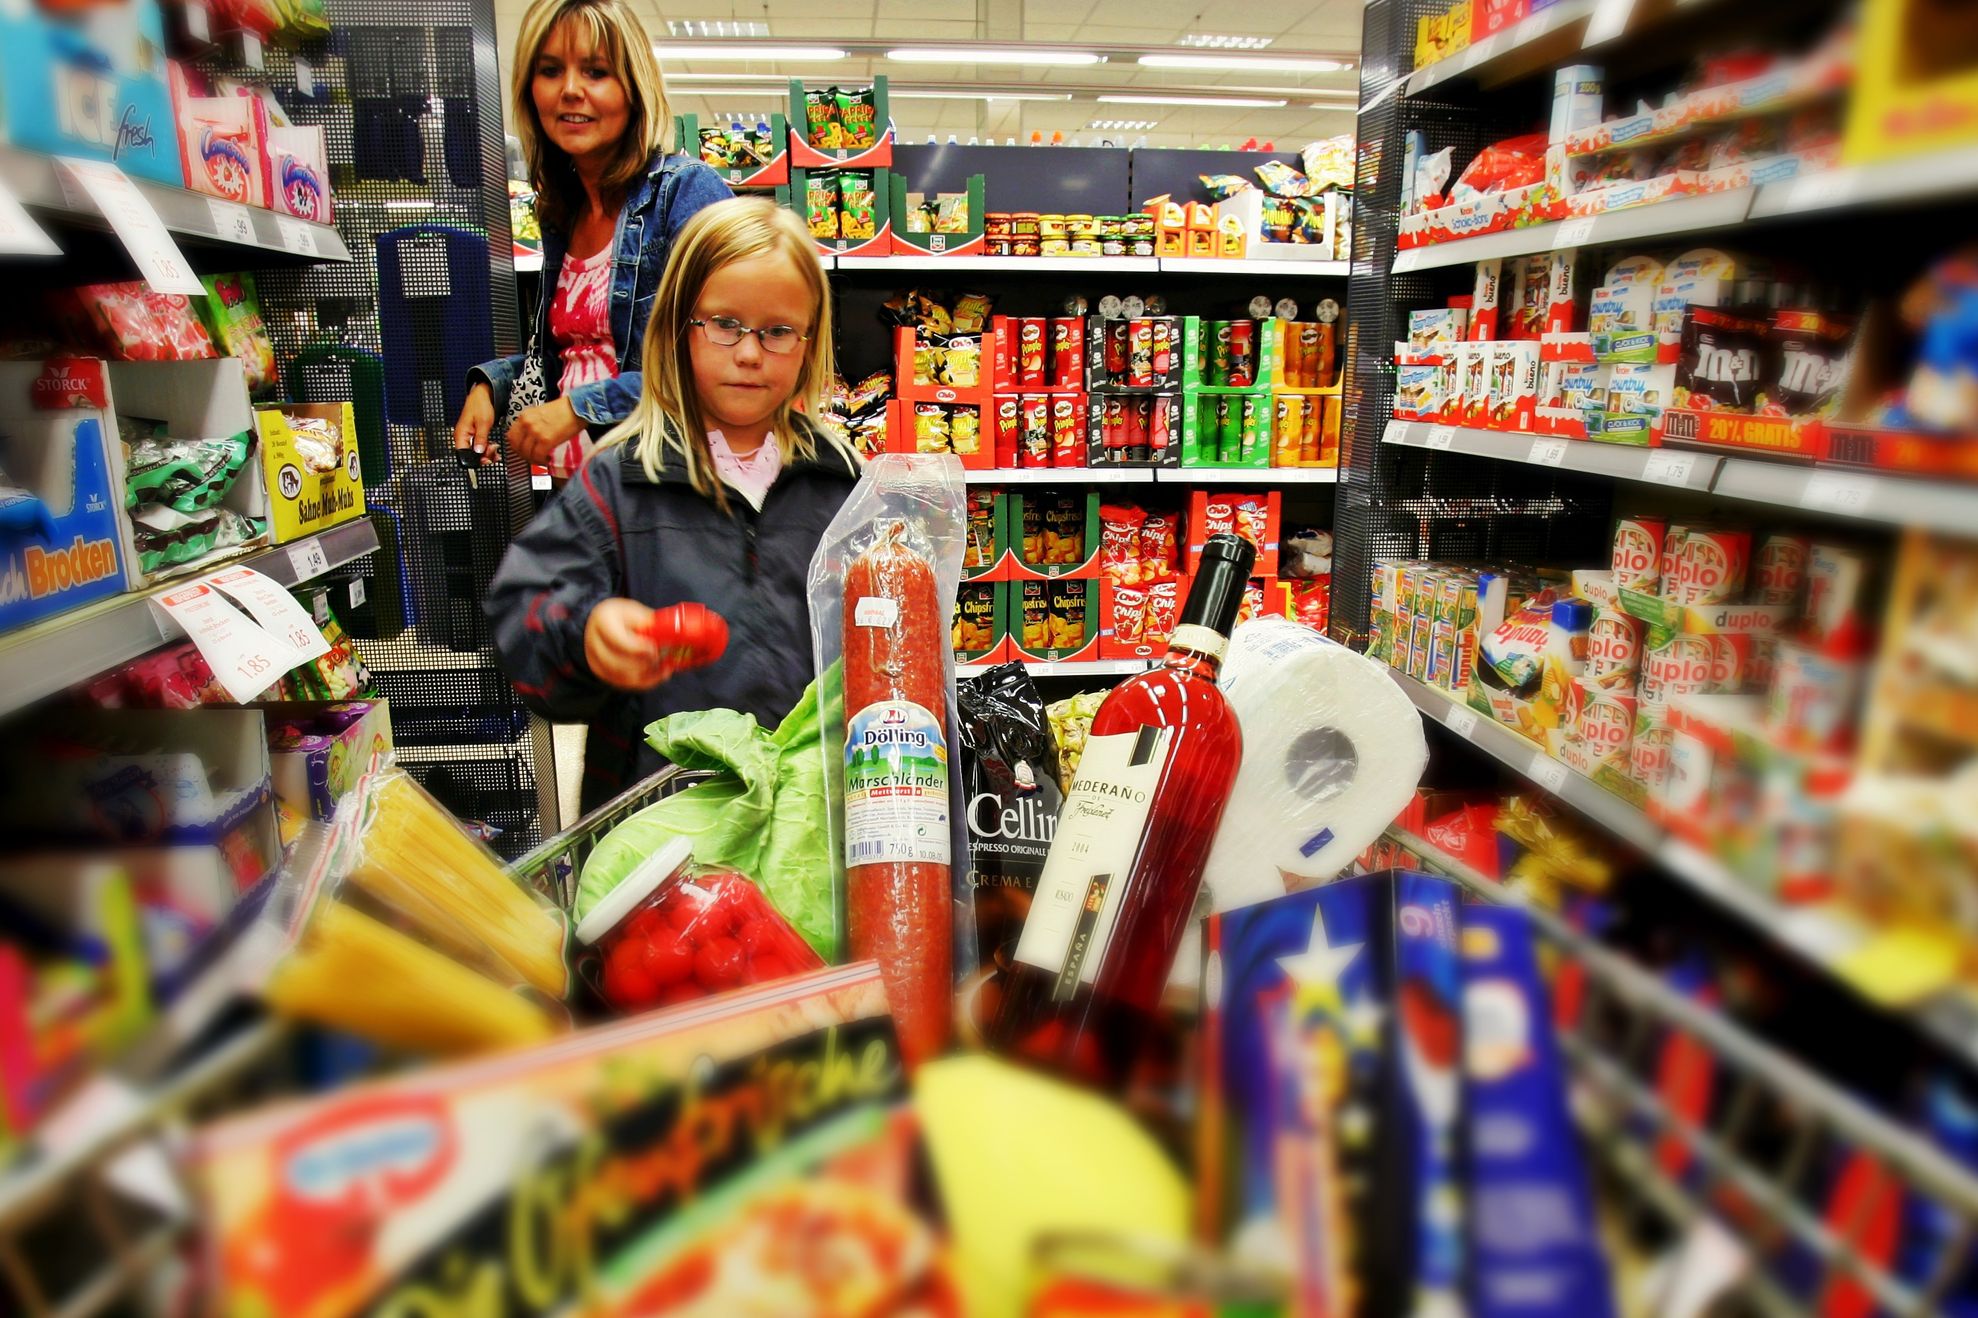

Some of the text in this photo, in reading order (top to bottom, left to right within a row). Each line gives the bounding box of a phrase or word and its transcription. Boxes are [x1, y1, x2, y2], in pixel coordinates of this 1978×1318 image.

[112, 104, 156, 162] fresh
[1559, 264, 1570, 296] bueno
[1021, 340, 1042, 355] Pringles
[37, 378, 88, 391] STORCK
[1526, 360, 1536, 389] bueno
[1709, 419, 1801, 448] 20% GRATIS
[299, 498, 321, 525] Sahne
[1207, 506, 1230, 515] Chio
[25, 535, 118, 600] Brocken
[306, 552, 322, 568] 1.49
[1119, 592, 1142, 601] Chio
[1583, 582, 1608, 600] duplo
[1714, 610, 1772, 631] duplo
[288, 629, 312, 650] 1.85
[237, 654, 272, 681] 1.85
[1560, 744, 1589, 771] duplo
[968, 843, 1047, 857] ESPRESSO ORIGINALE
[966, 870, 1032, 888] CREMA E
[1065, 933, 1087, 985] ESPAÑA
